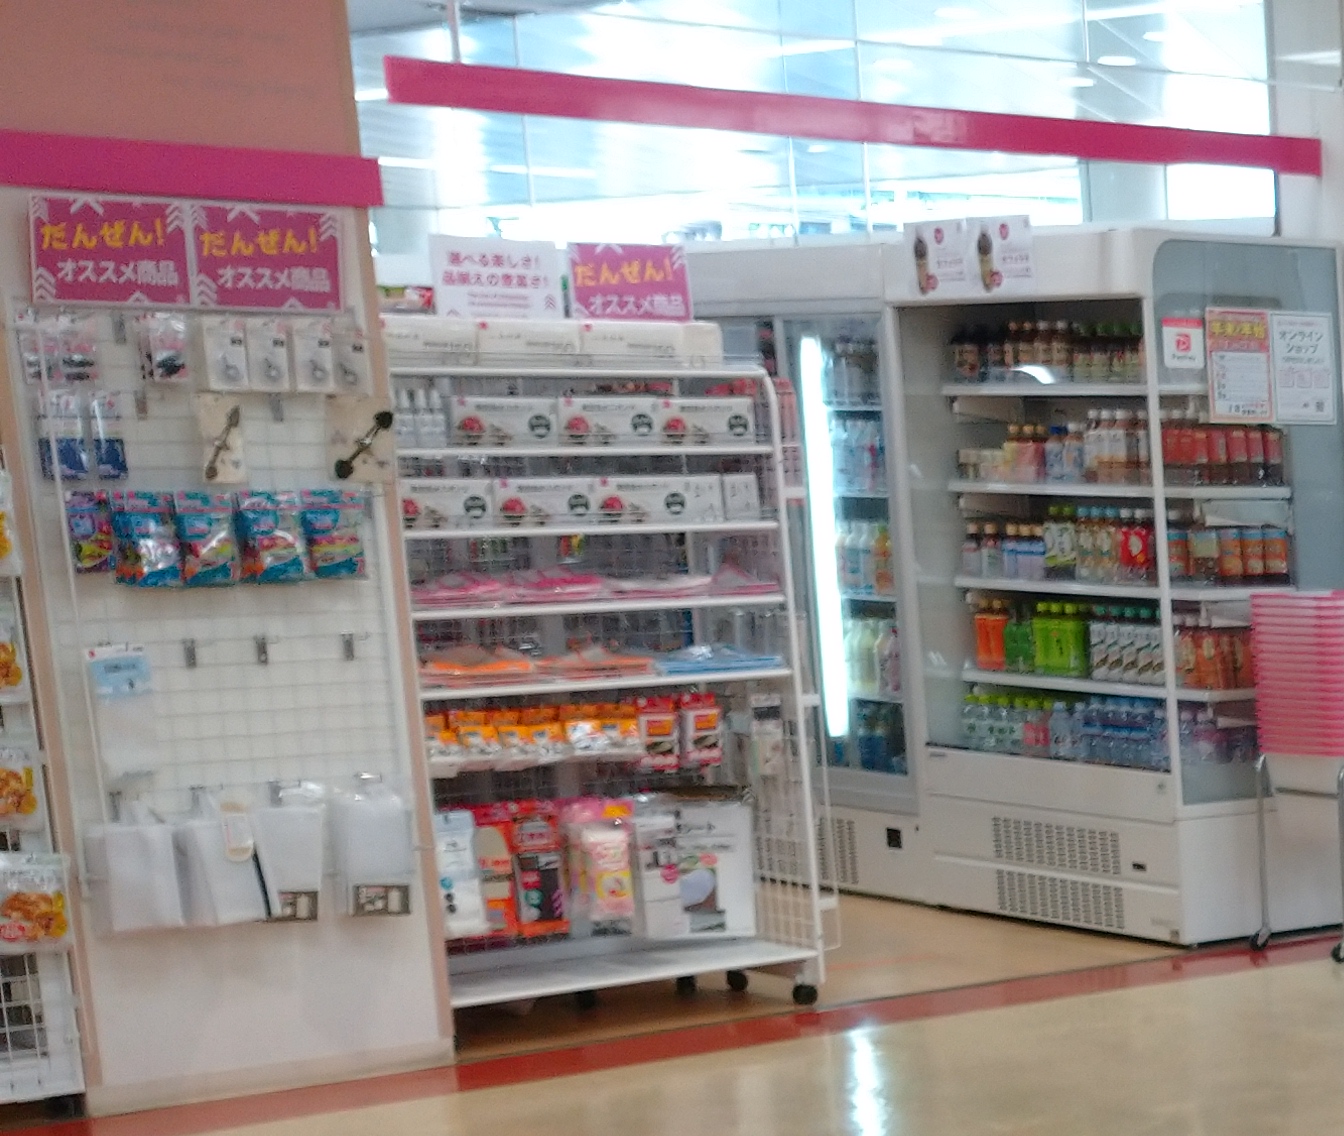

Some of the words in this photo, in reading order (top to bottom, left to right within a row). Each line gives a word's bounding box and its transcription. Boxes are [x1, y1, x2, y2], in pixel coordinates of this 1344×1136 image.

[57, 257, 179, 287] オススメ商品
[216, 266, 332, 294] オススメ商品
[588, 292, 686, 317] オススメ商品
[1279, 330, 1324, 342] オンライン
